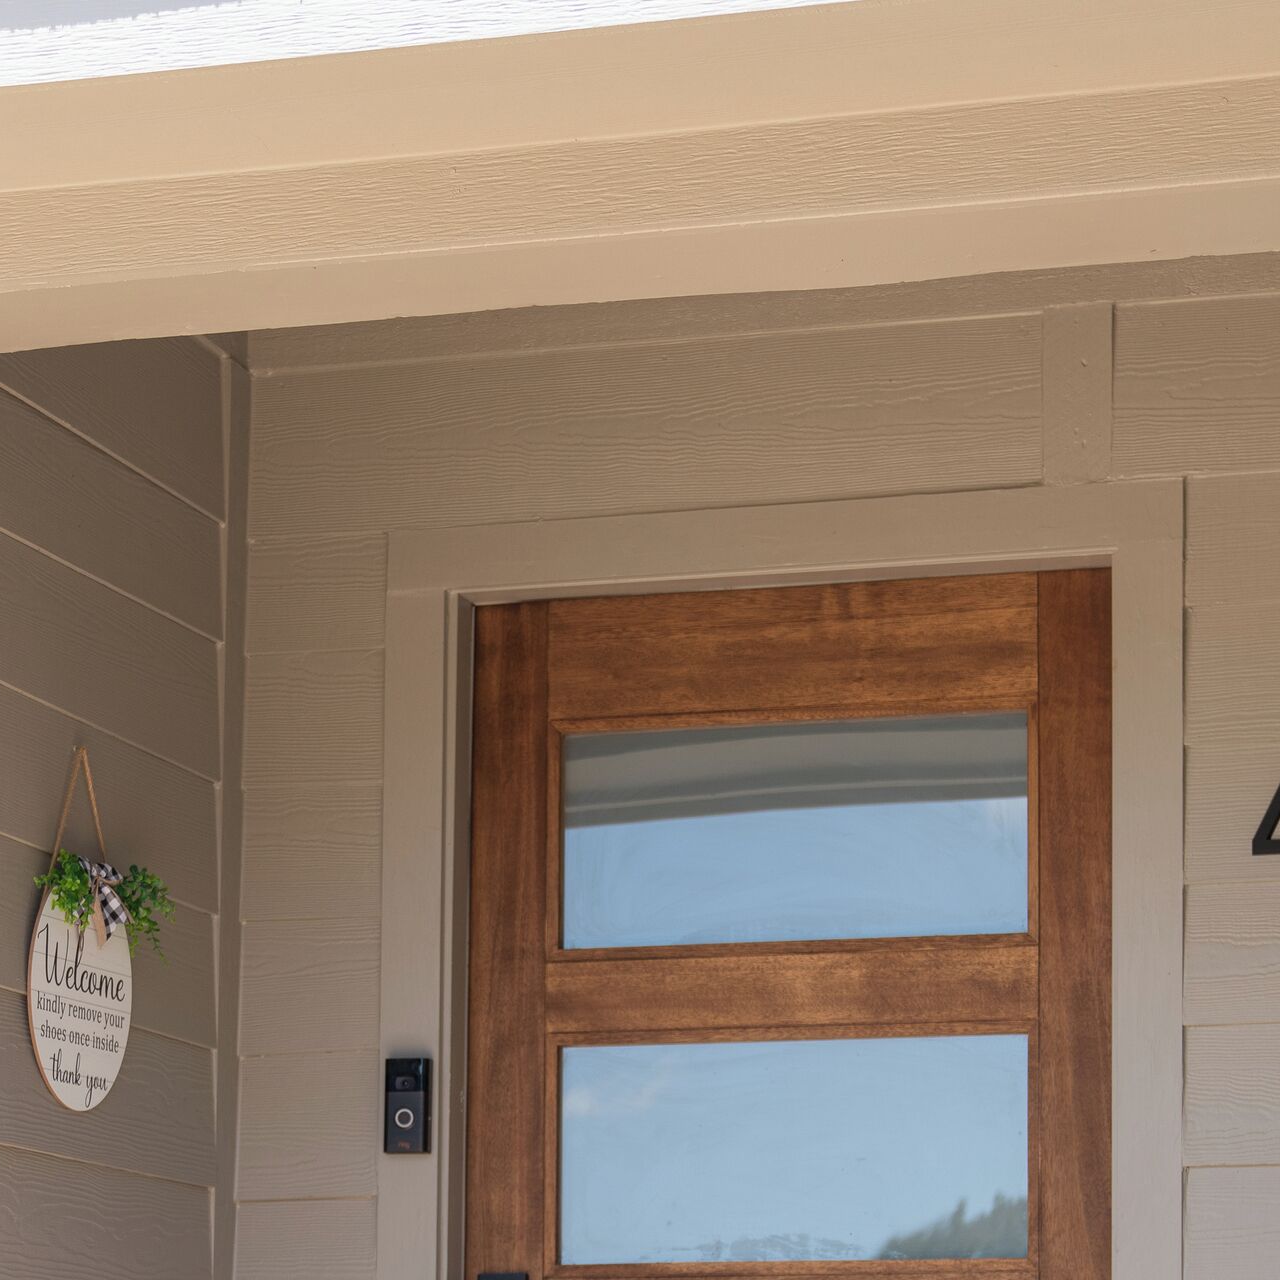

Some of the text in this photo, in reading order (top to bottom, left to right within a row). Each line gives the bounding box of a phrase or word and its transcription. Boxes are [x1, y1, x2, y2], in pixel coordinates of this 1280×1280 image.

[37, 923, 126, 1002] Welcome
[36, 990, 125, 1030] kindly remove your
[40, 1019, 120, 1054] shoes once inside
[49, 1049, 109, 1108] thank you
